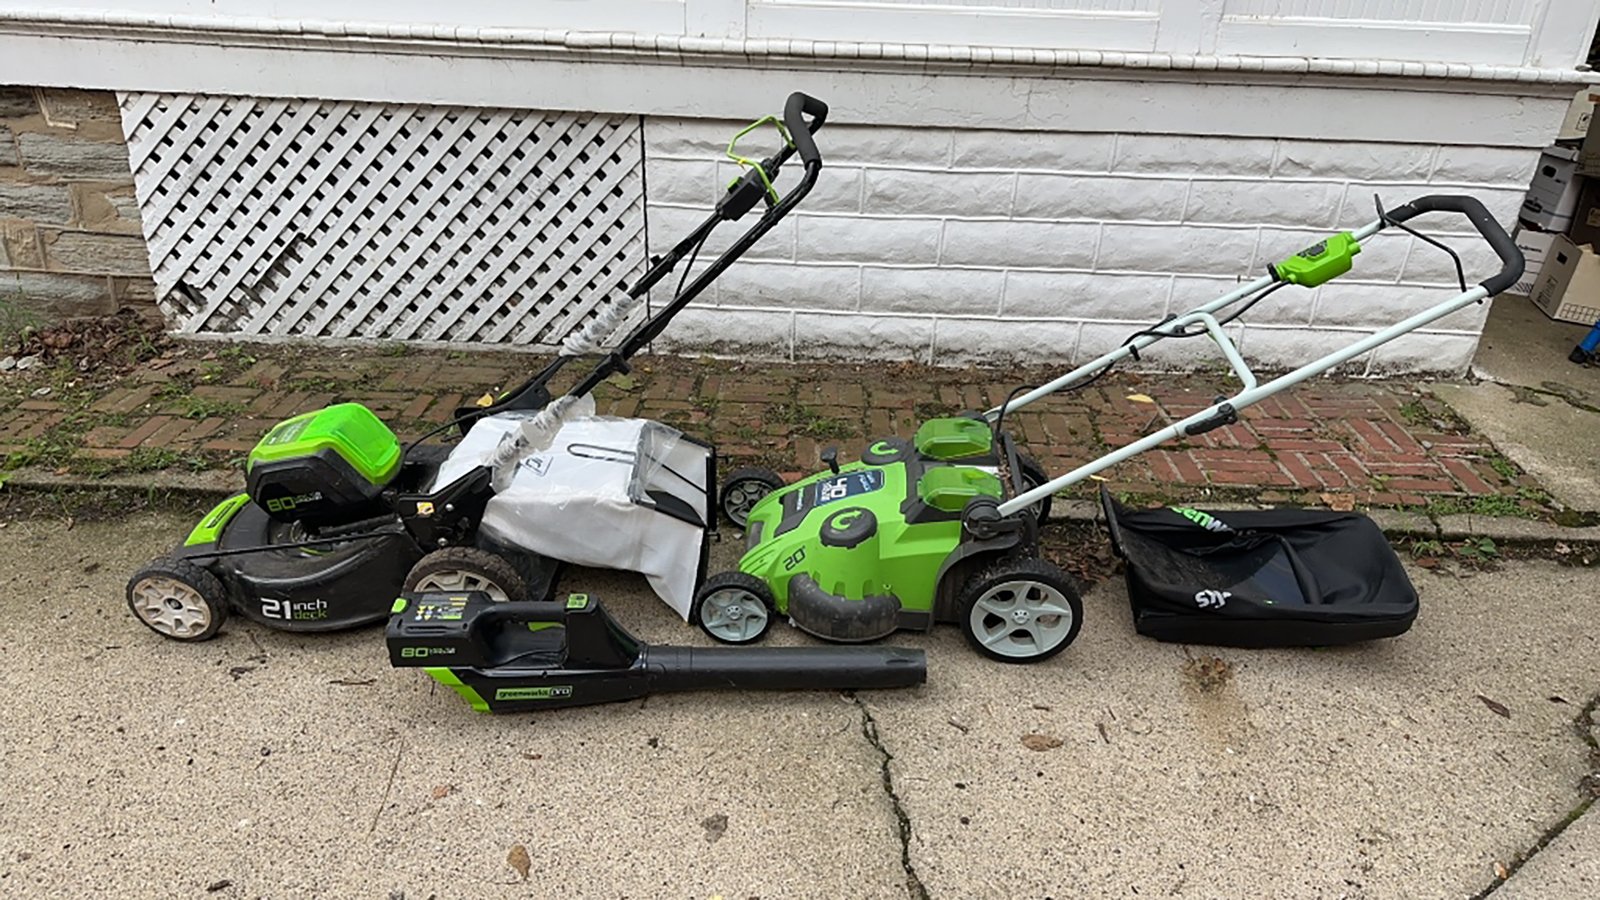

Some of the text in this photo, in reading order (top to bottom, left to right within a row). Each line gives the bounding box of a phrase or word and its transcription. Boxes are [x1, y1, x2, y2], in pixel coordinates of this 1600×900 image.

[266, 497, 296, 512] 80
[260, 597, 328, 619] 21 inch
[294, 609, 328, 620] deck
[401, 647, 428, 657] 80
